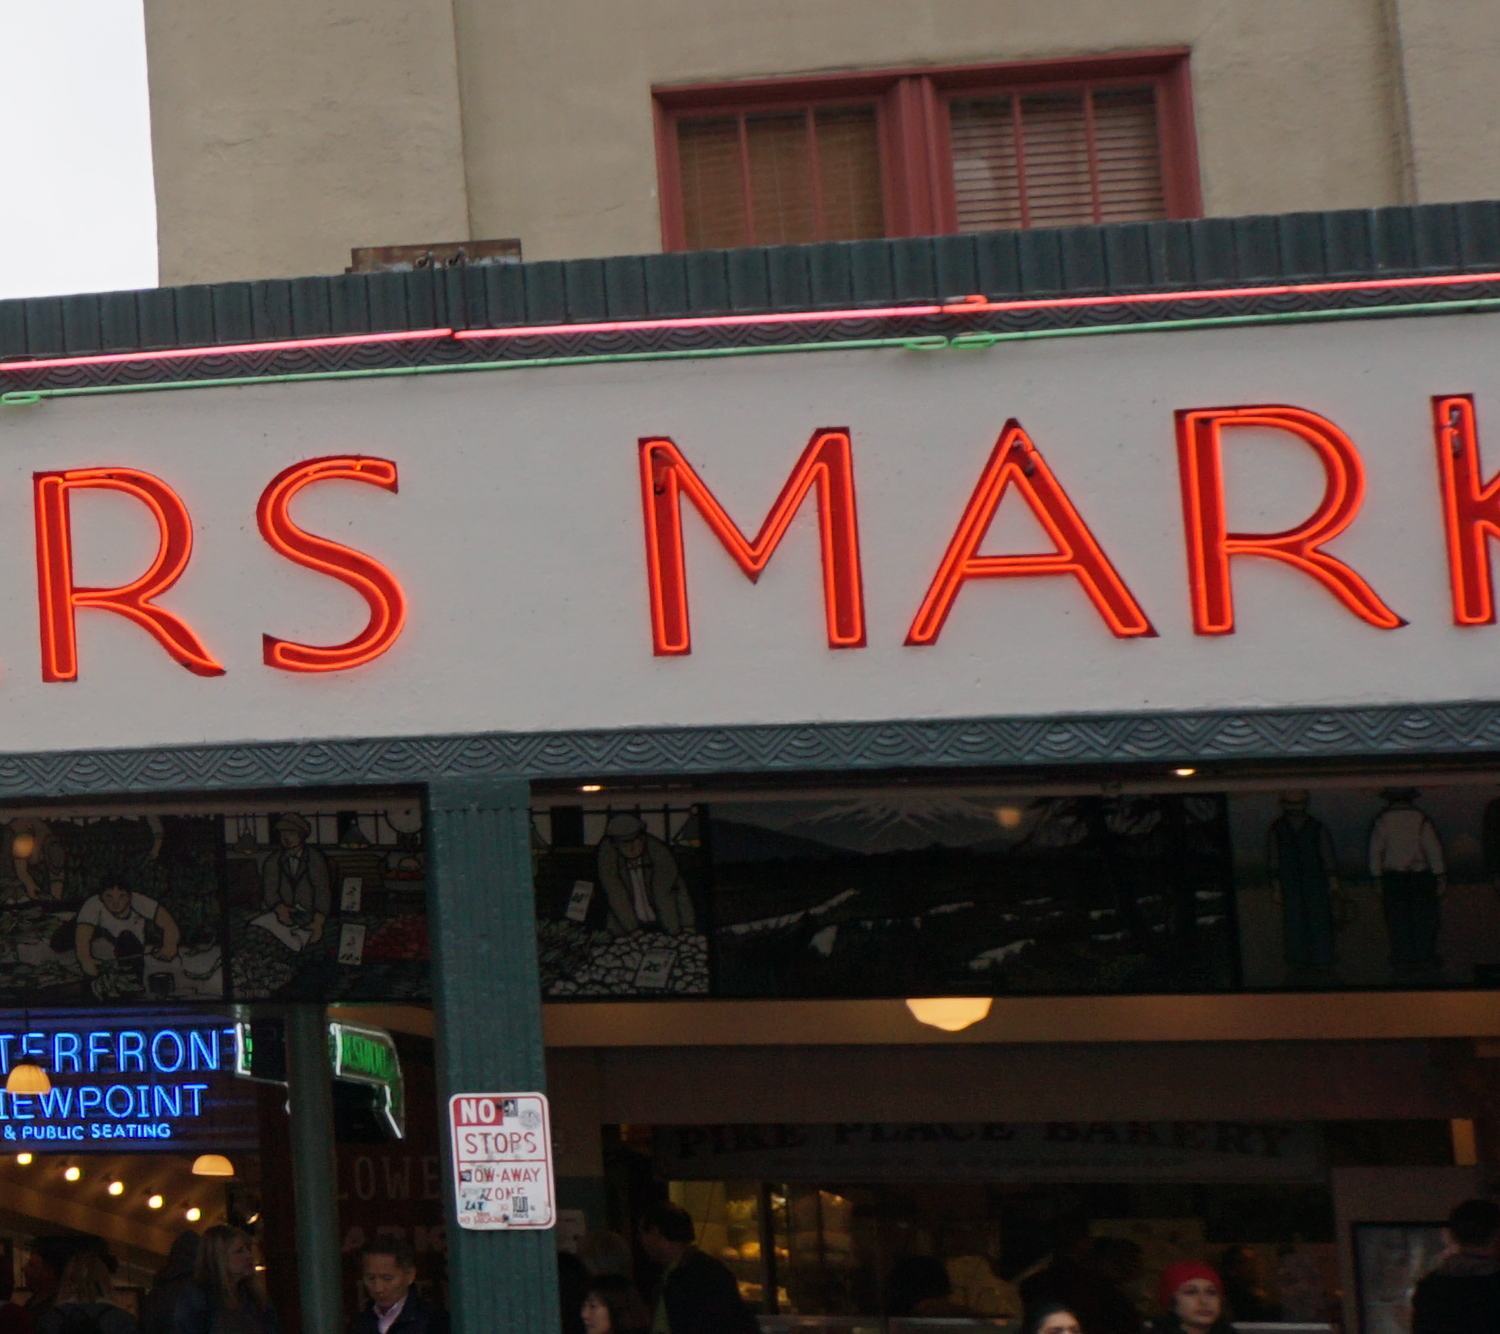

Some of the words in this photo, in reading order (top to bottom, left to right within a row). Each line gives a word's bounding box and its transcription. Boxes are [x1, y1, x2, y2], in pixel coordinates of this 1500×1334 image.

[460, 1098, 496, 1124] NO
[3, 1125, 17, 1141] &
[21, 1125, 86, 1141] PUBLIC
[90, 1123, 171, 1140] SEATING
[464, 1131, 538, 1155] STOPS
